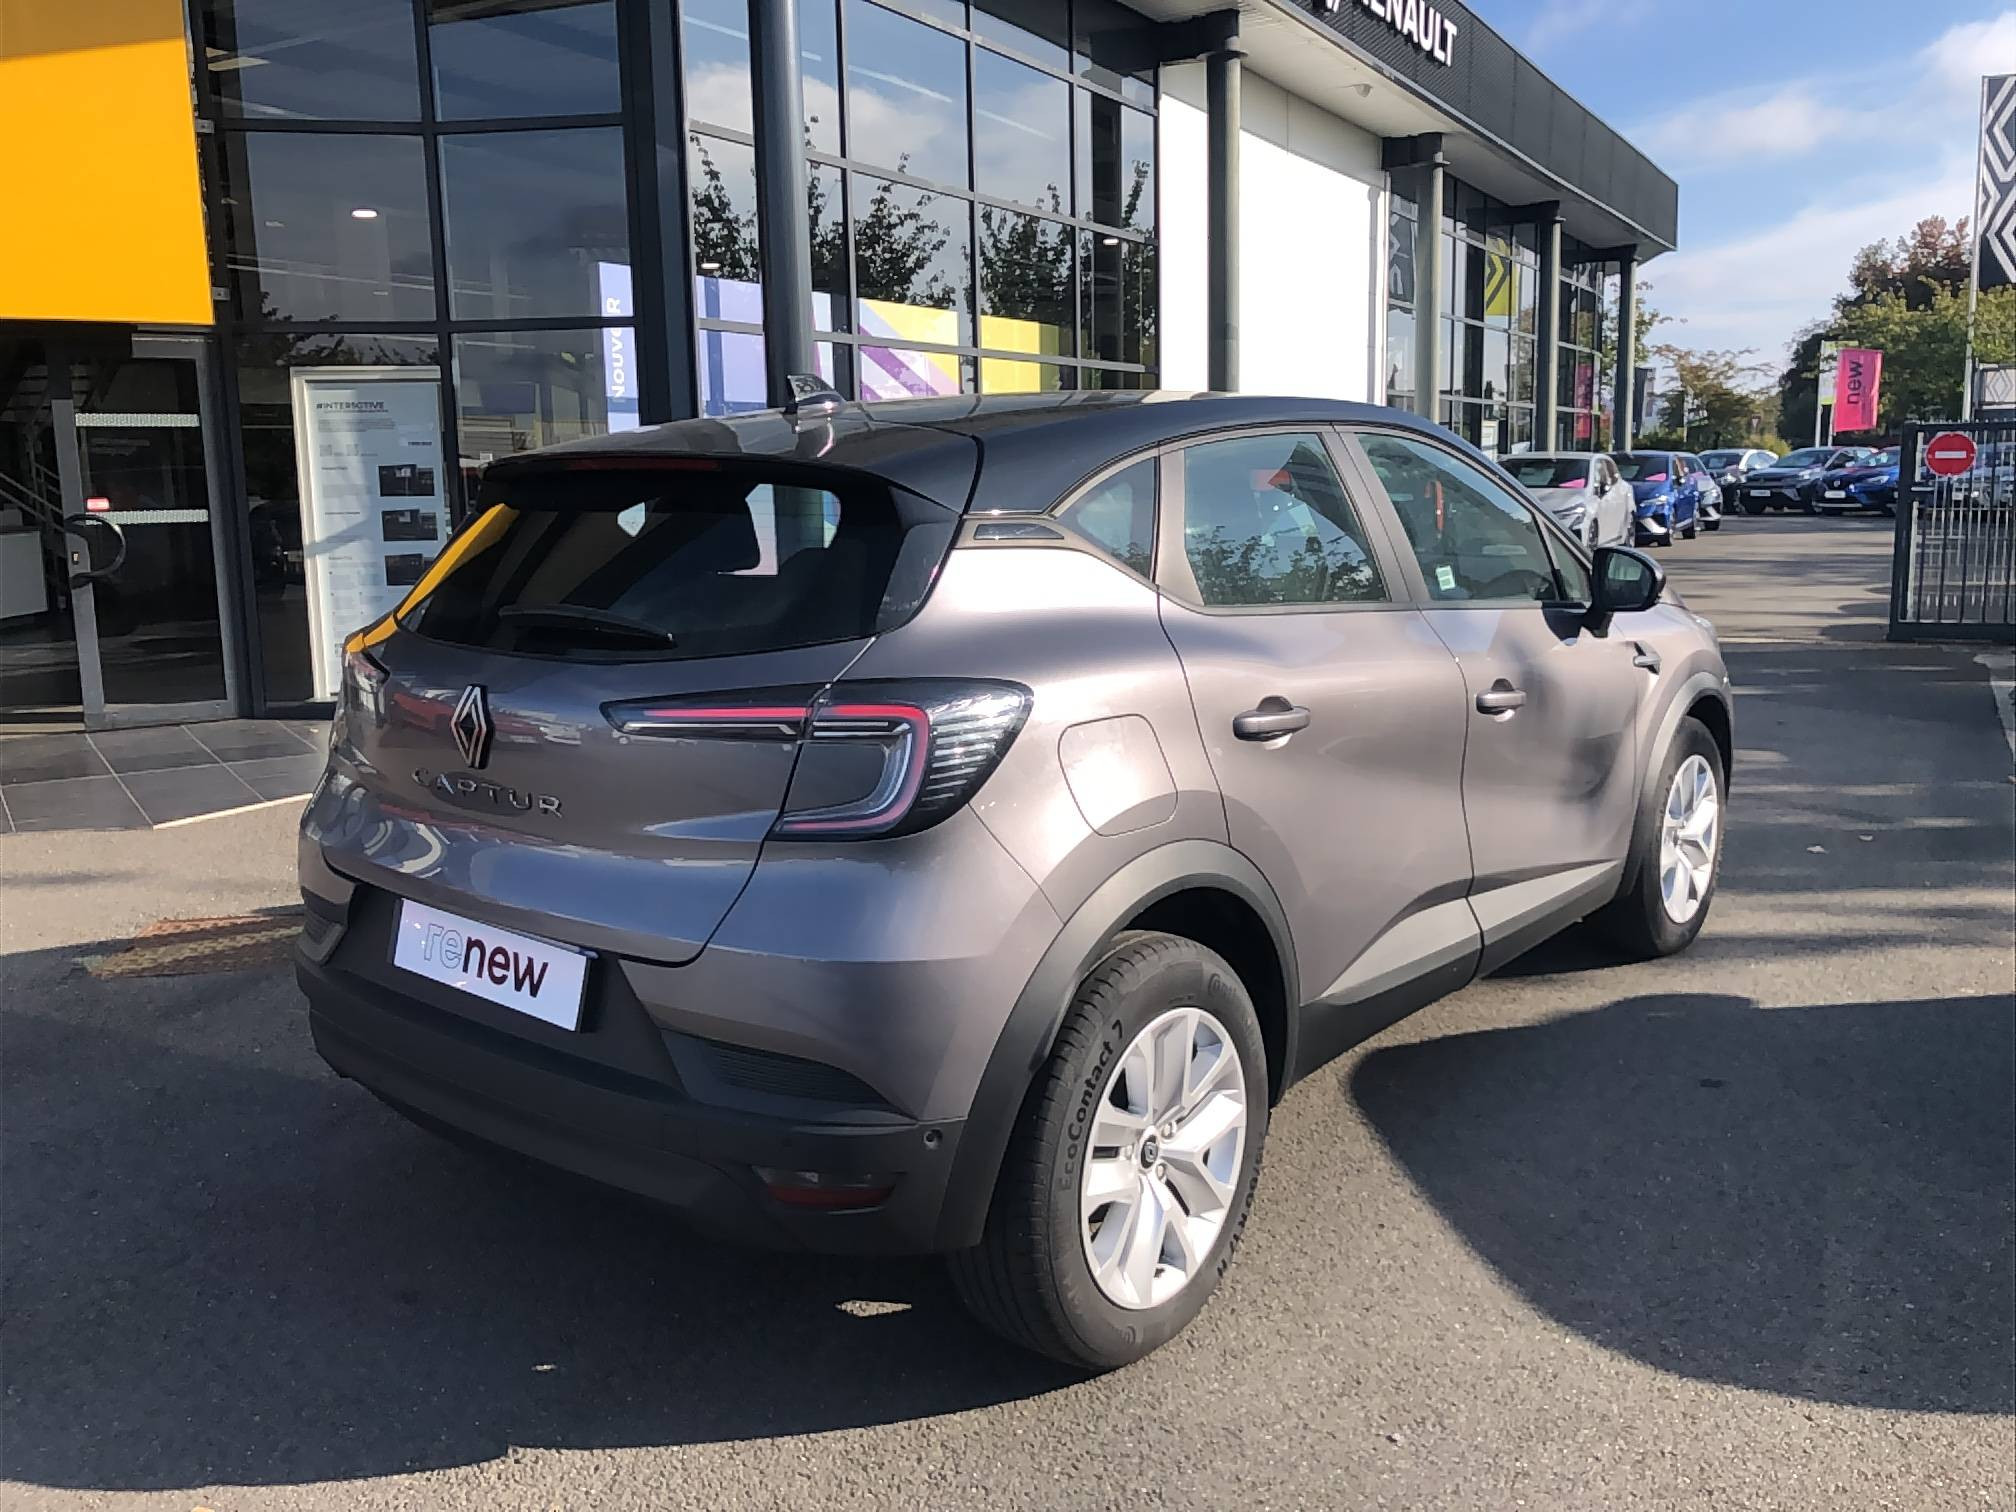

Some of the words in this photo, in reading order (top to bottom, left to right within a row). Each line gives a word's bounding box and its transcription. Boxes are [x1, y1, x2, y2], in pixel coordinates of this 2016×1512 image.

[1362, 0, 1457, 67] NAULT
[410, 767, 563, 818] CAPTUR
[424, 923, 549, 998] renew
[1058, 1041, 1114, 1191] EcoContact
